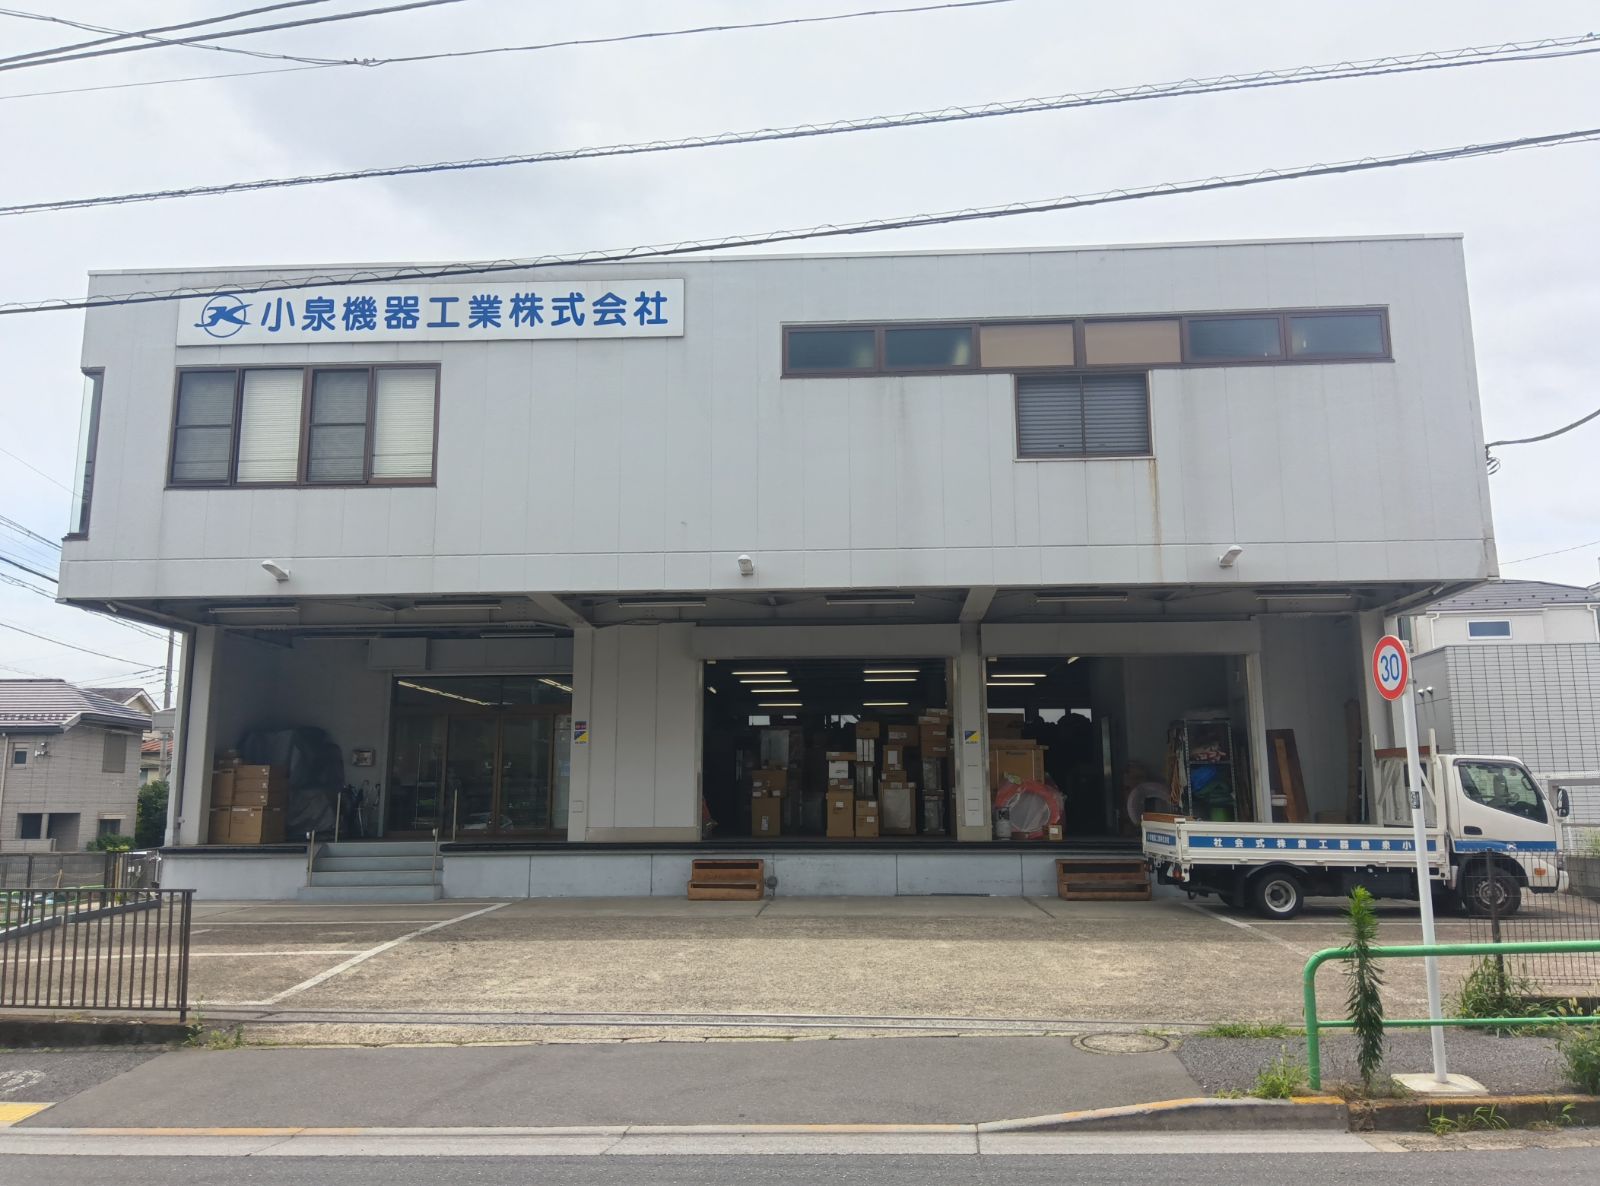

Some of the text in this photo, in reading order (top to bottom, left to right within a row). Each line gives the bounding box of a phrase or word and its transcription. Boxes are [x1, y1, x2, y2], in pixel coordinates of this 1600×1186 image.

[260, 290, 668, 332] 小泉機器工業株式会社
[1380, 653, 1399, 682] 30
